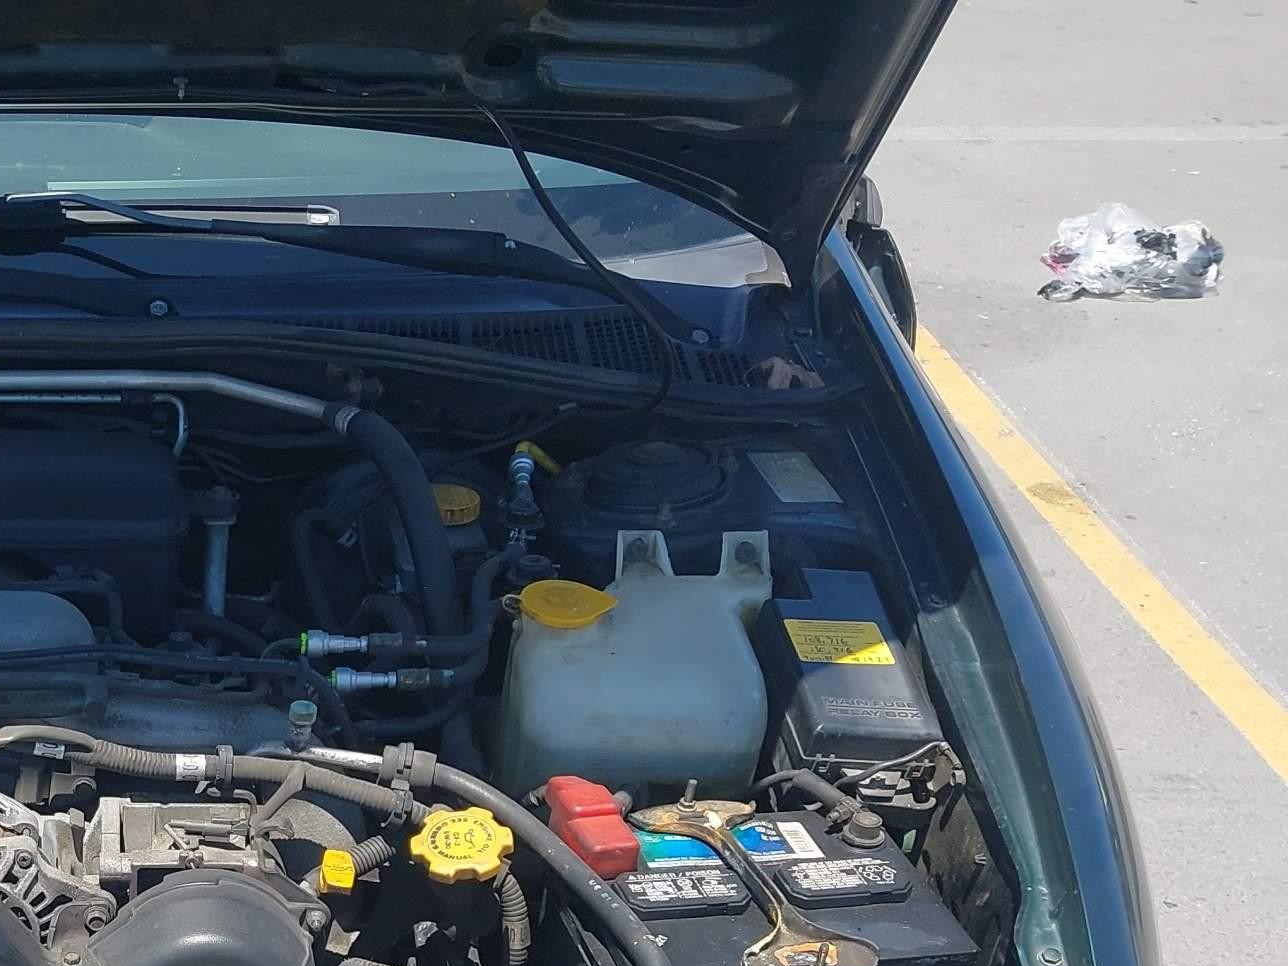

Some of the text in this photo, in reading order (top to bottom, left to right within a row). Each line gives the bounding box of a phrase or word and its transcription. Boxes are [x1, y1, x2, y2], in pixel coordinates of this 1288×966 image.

[822, 697, 916, 708] MAIN FUSE
[827, 708, 922, 720] RELAY BOX
[477, 843, 490, 854] OIL
[437, 850, 475, 860] MANUAL
[637, 870, 677, 880] DANGER
[686, 869, 721, 877] POISON
